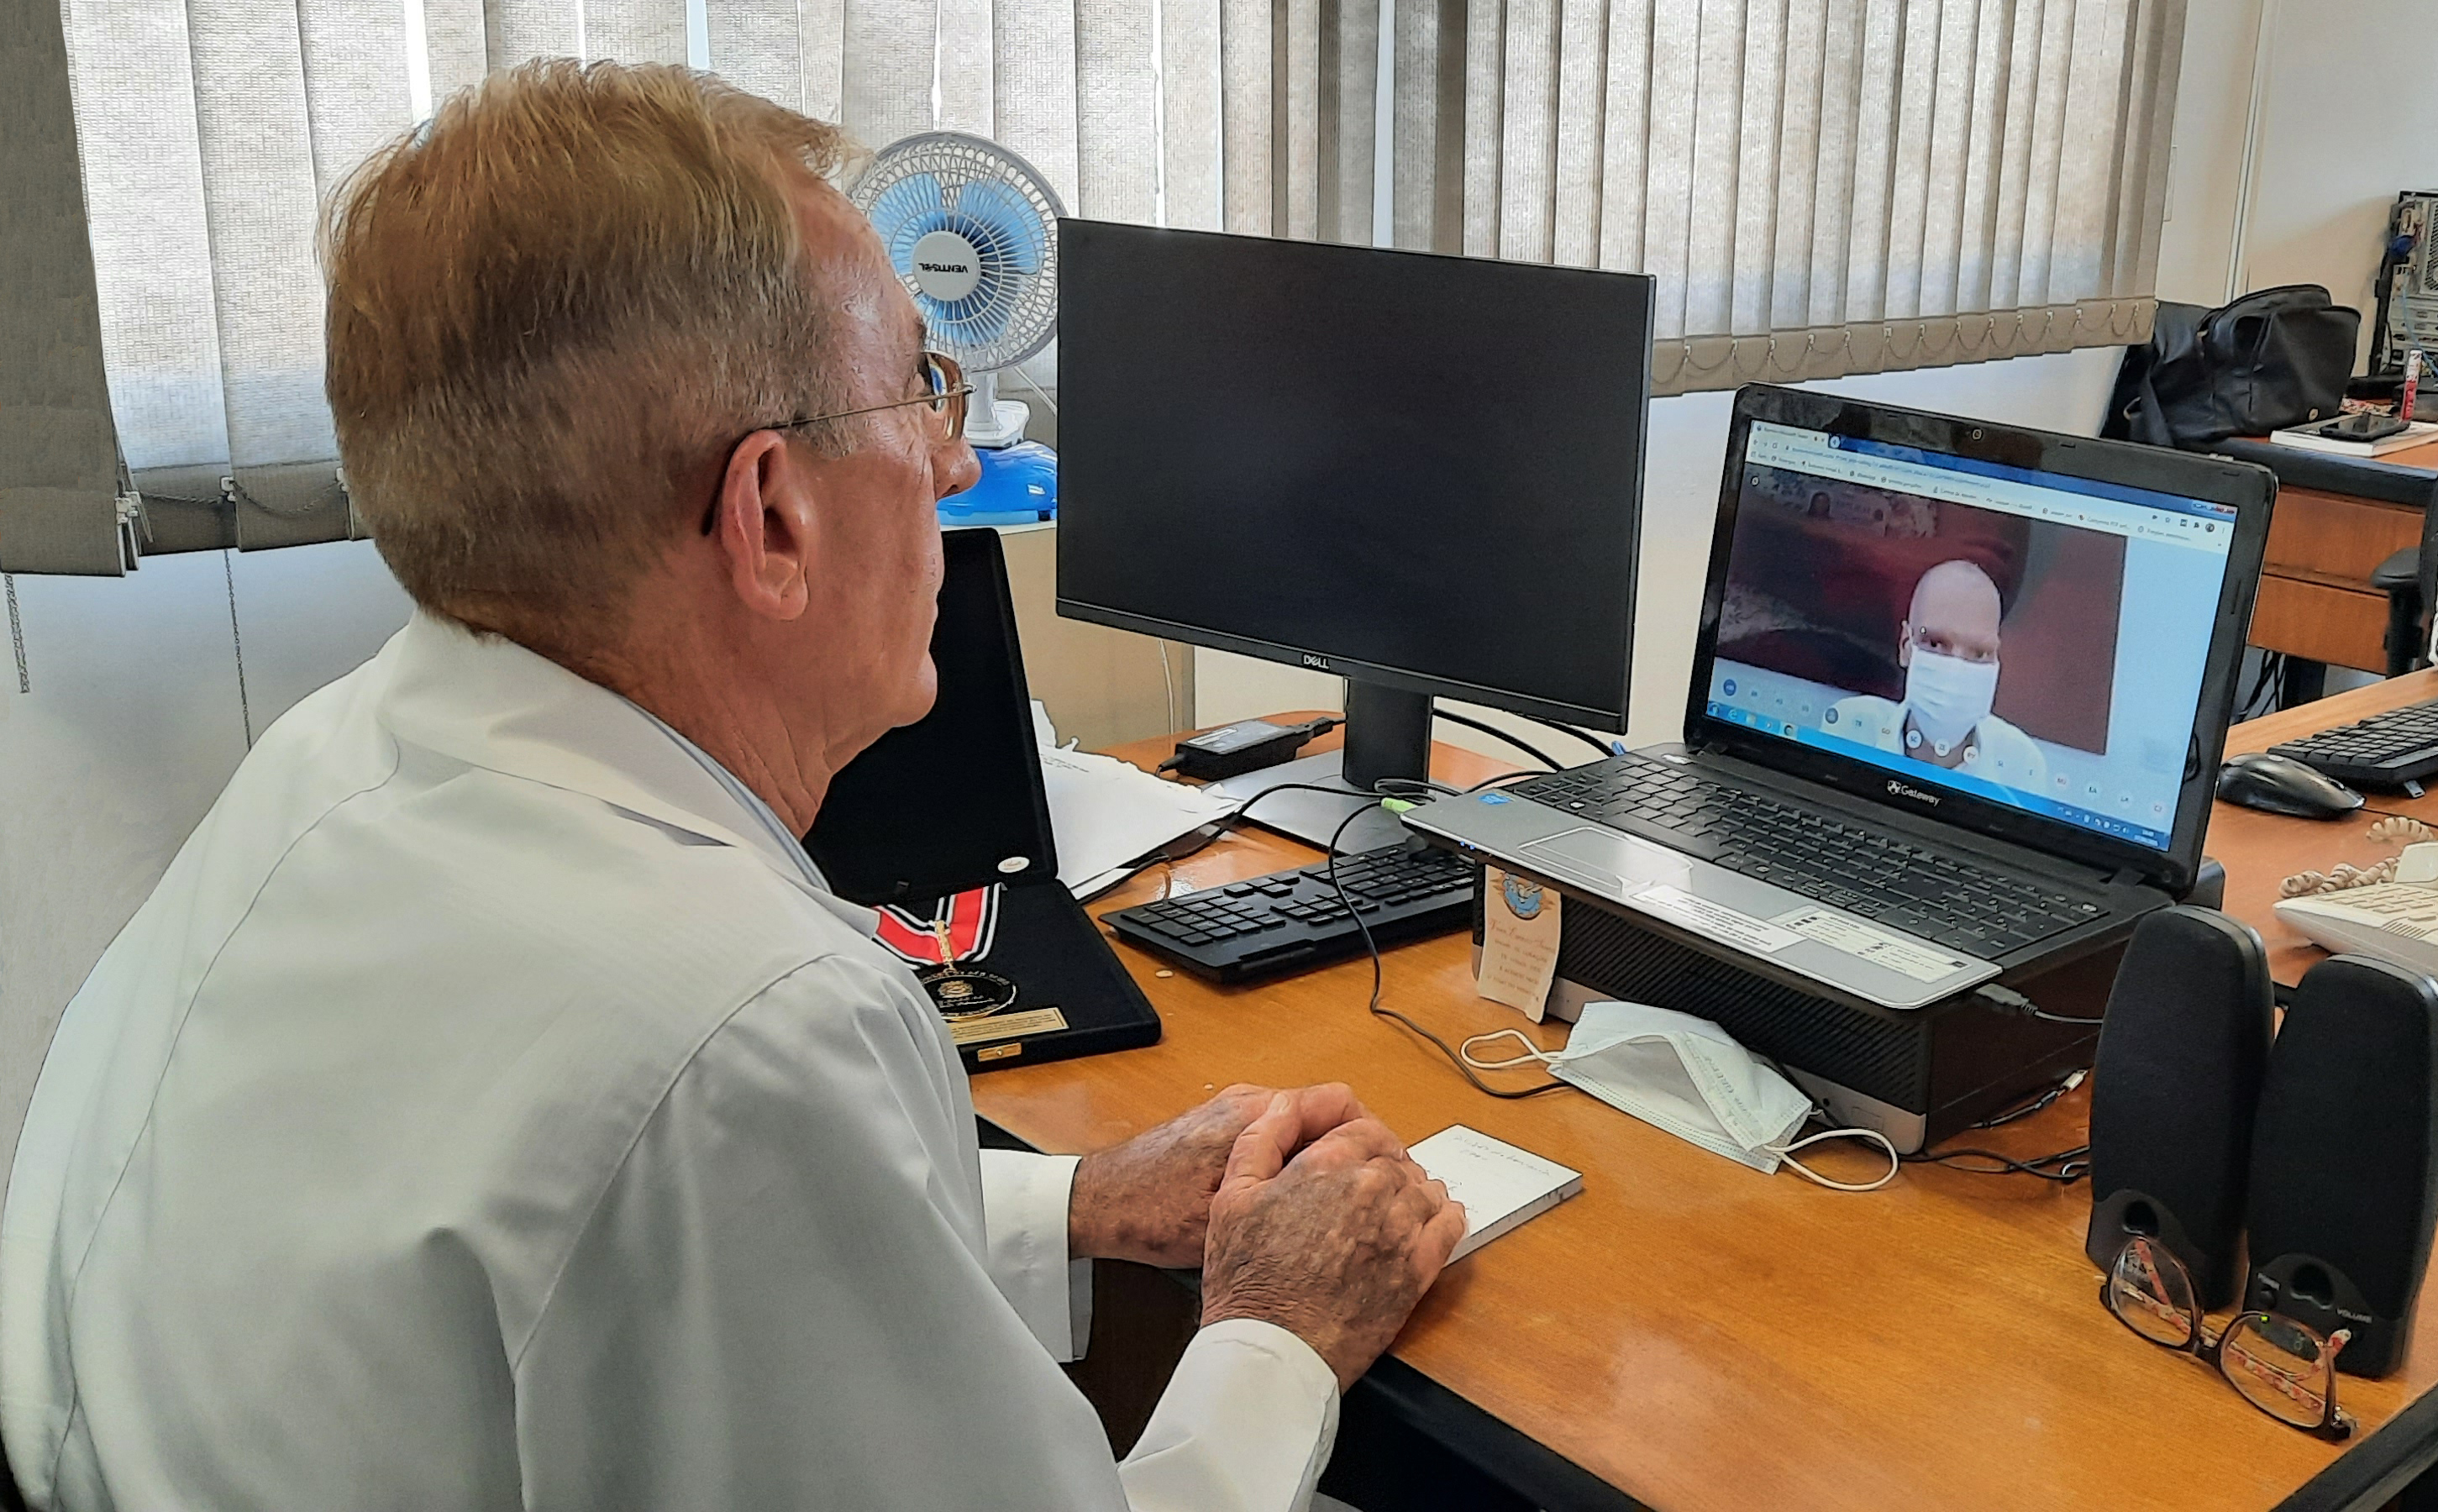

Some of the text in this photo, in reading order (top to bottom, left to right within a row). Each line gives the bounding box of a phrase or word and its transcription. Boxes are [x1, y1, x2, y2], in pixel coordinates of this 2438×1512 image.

[1303, 654, 1330, 669] DELL
[1900, 785, 1941, 807] Gateway
[2336, 1308, 2373, 1324] VOLUME
